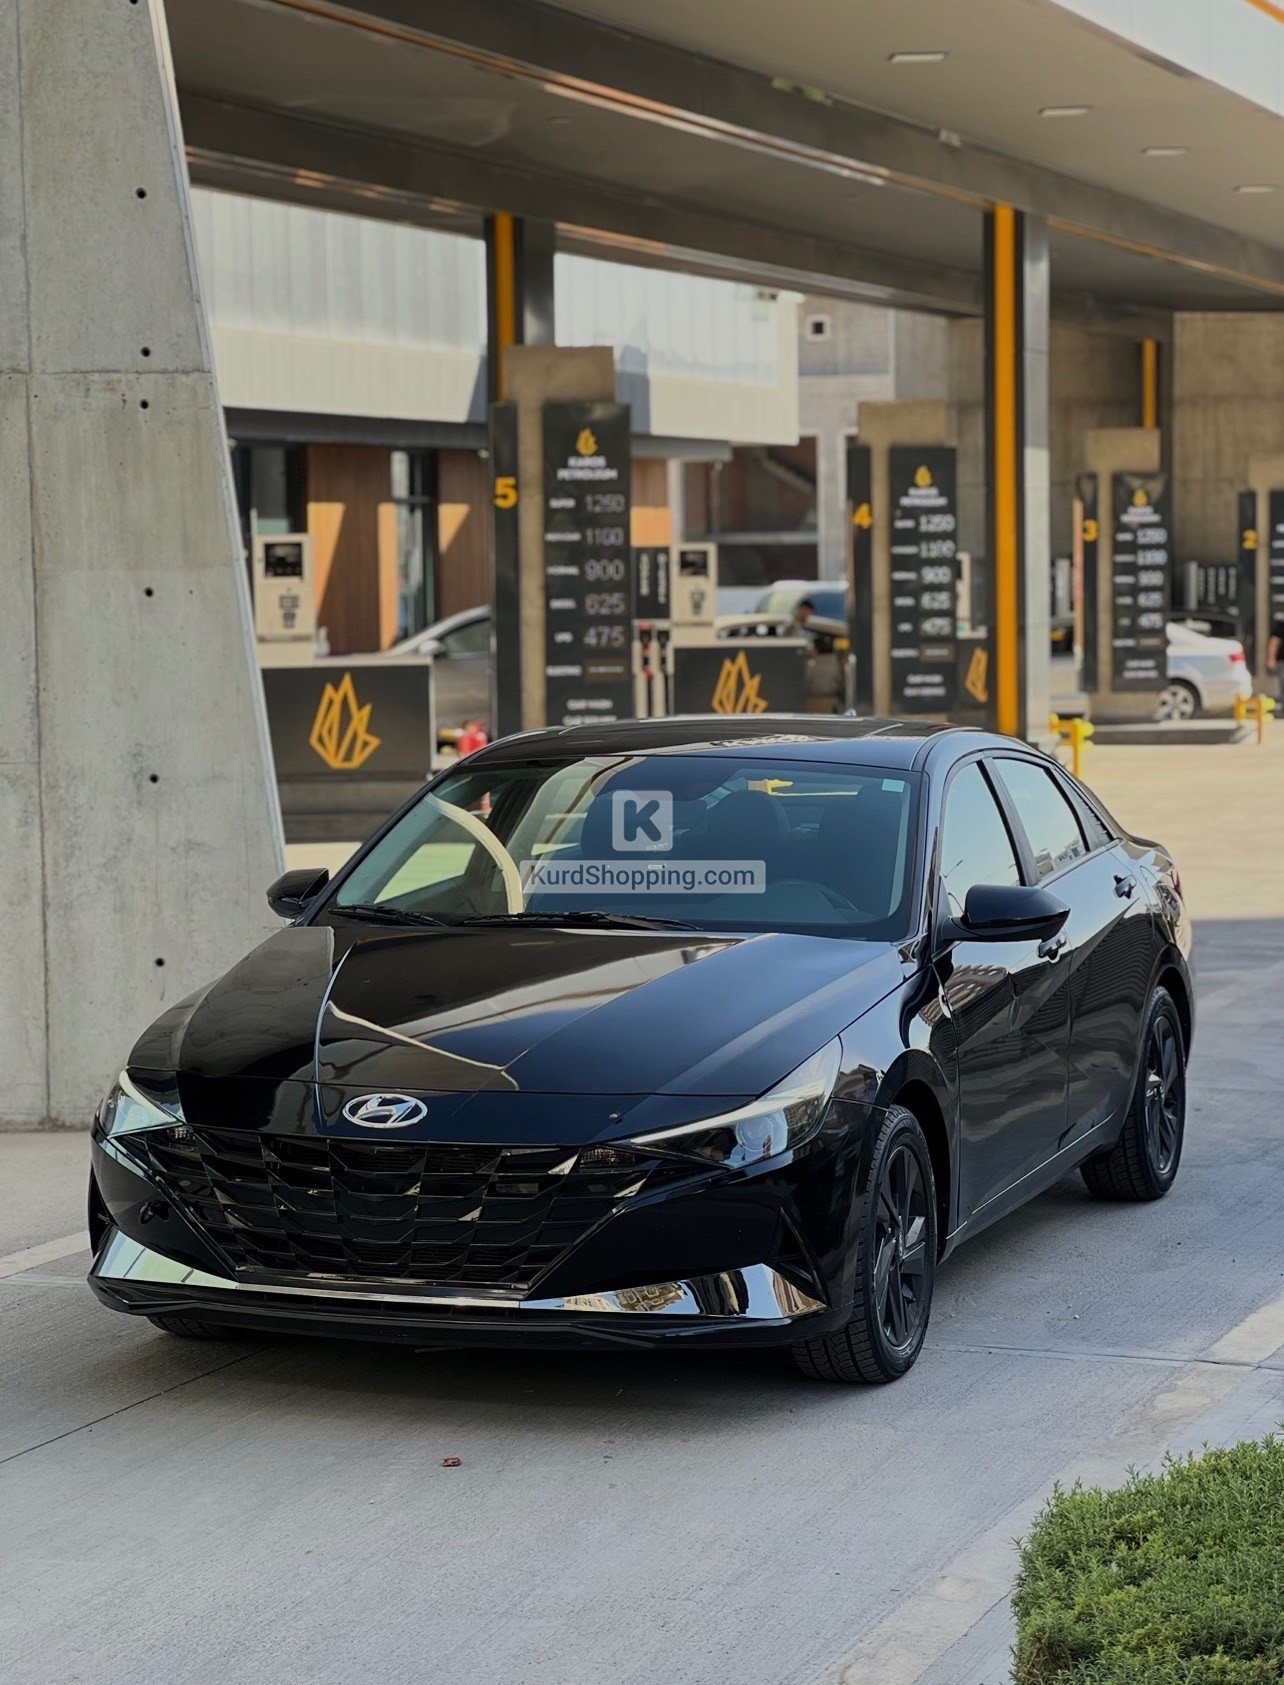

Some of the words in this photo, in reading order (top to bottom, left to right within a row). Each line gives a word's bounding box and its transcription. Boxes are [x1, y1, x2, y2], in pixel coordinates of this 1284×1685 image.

[494, 476, 518, 509] 5
[585, 494, 626, 513] 1250
[853, 502, 872, 529] 4
[585, 527, 625, 546] 1100
[1082, 519, 1098, 541] 3
[1242, 529, 1258, 550] 2
[584, 559, 625, 581] 900
[584, 592, 626, 615] 625
[582, 625, 625, 648] 475
